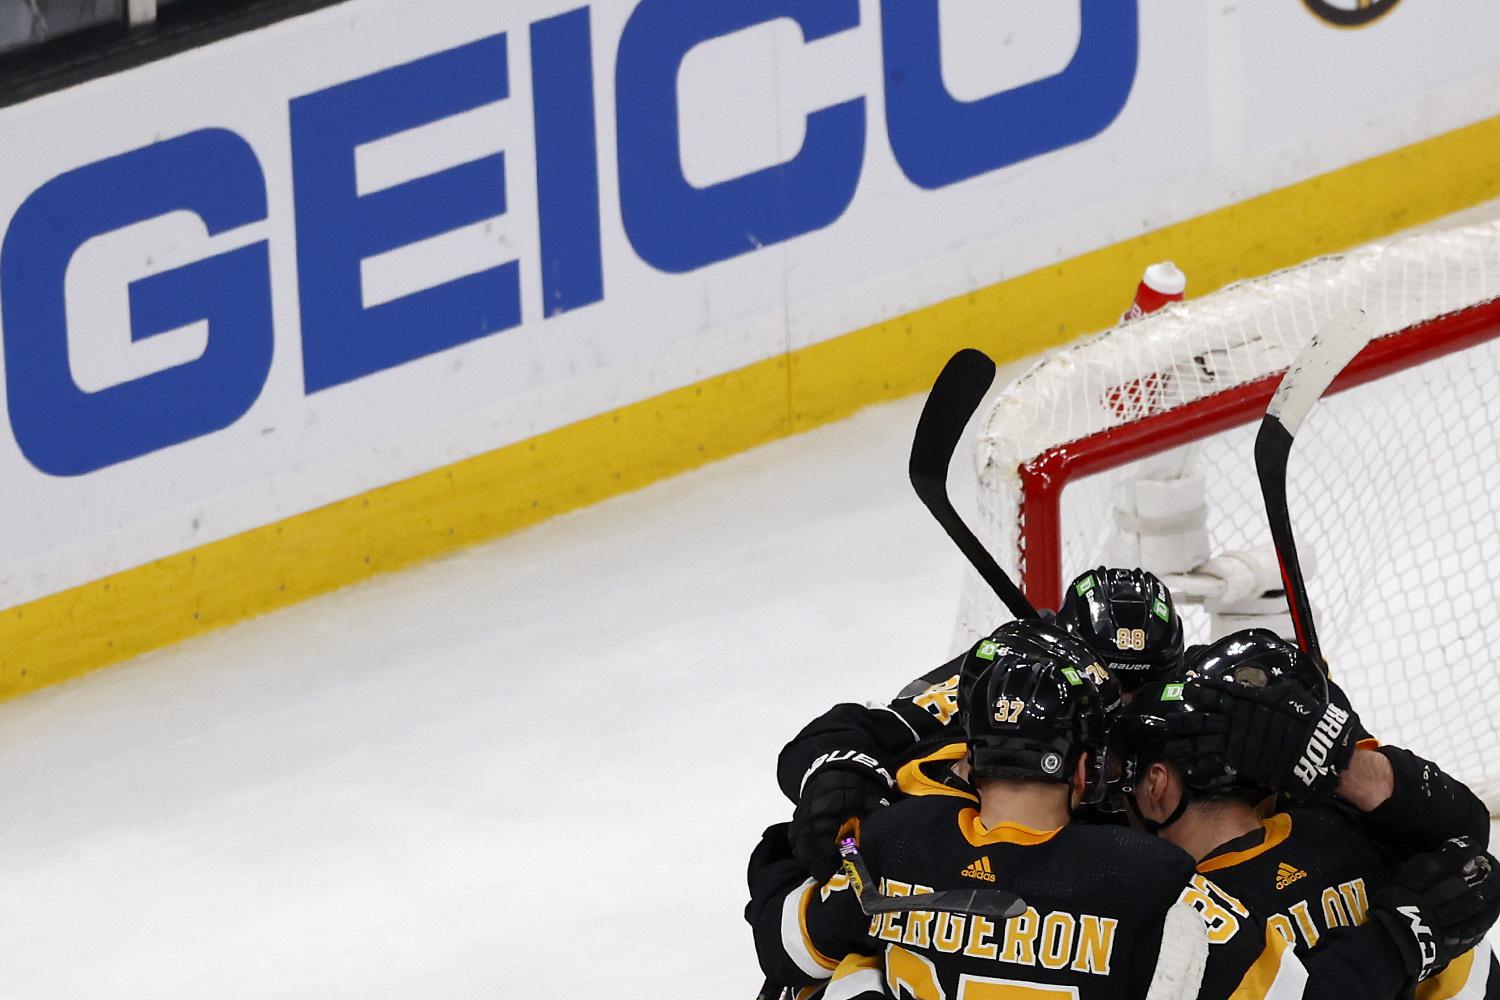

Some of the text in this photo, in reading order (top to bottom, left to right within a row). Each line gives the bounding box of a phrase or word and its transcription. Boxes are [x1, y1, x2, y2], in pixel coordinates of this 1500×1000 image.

[0, 0, 1140, 477] GEICO
[1117, 628, 1145, 650] 88
[994, 700, 1025, 723] 37
[961, 867, 996, 882] adidas
[1276, 869, 1308, 890] adidas
